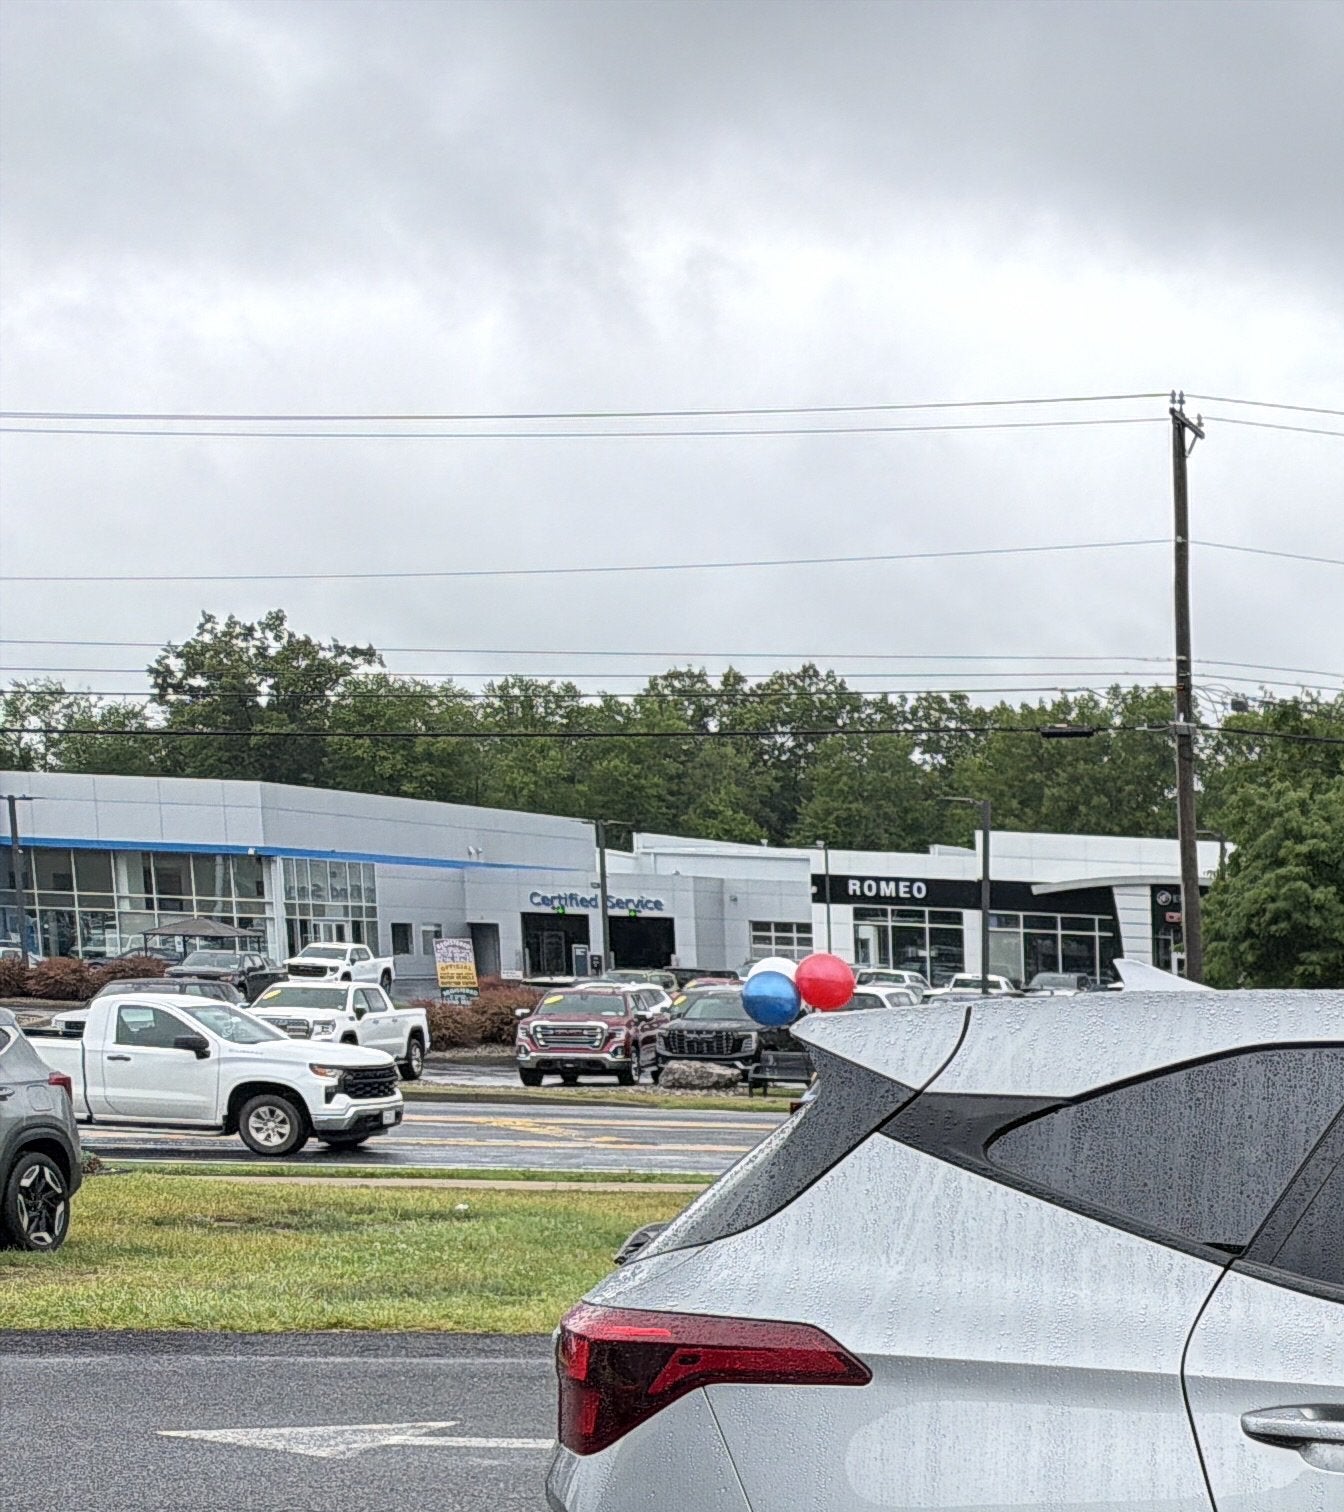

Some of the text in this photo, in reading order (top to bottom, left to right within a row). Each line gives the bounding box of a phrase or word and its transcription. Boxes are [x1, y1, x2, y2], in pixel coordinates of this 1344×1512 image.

[847, 879, 927, 899] ROMEO
[529, 891, 664, 911] Certified Service
